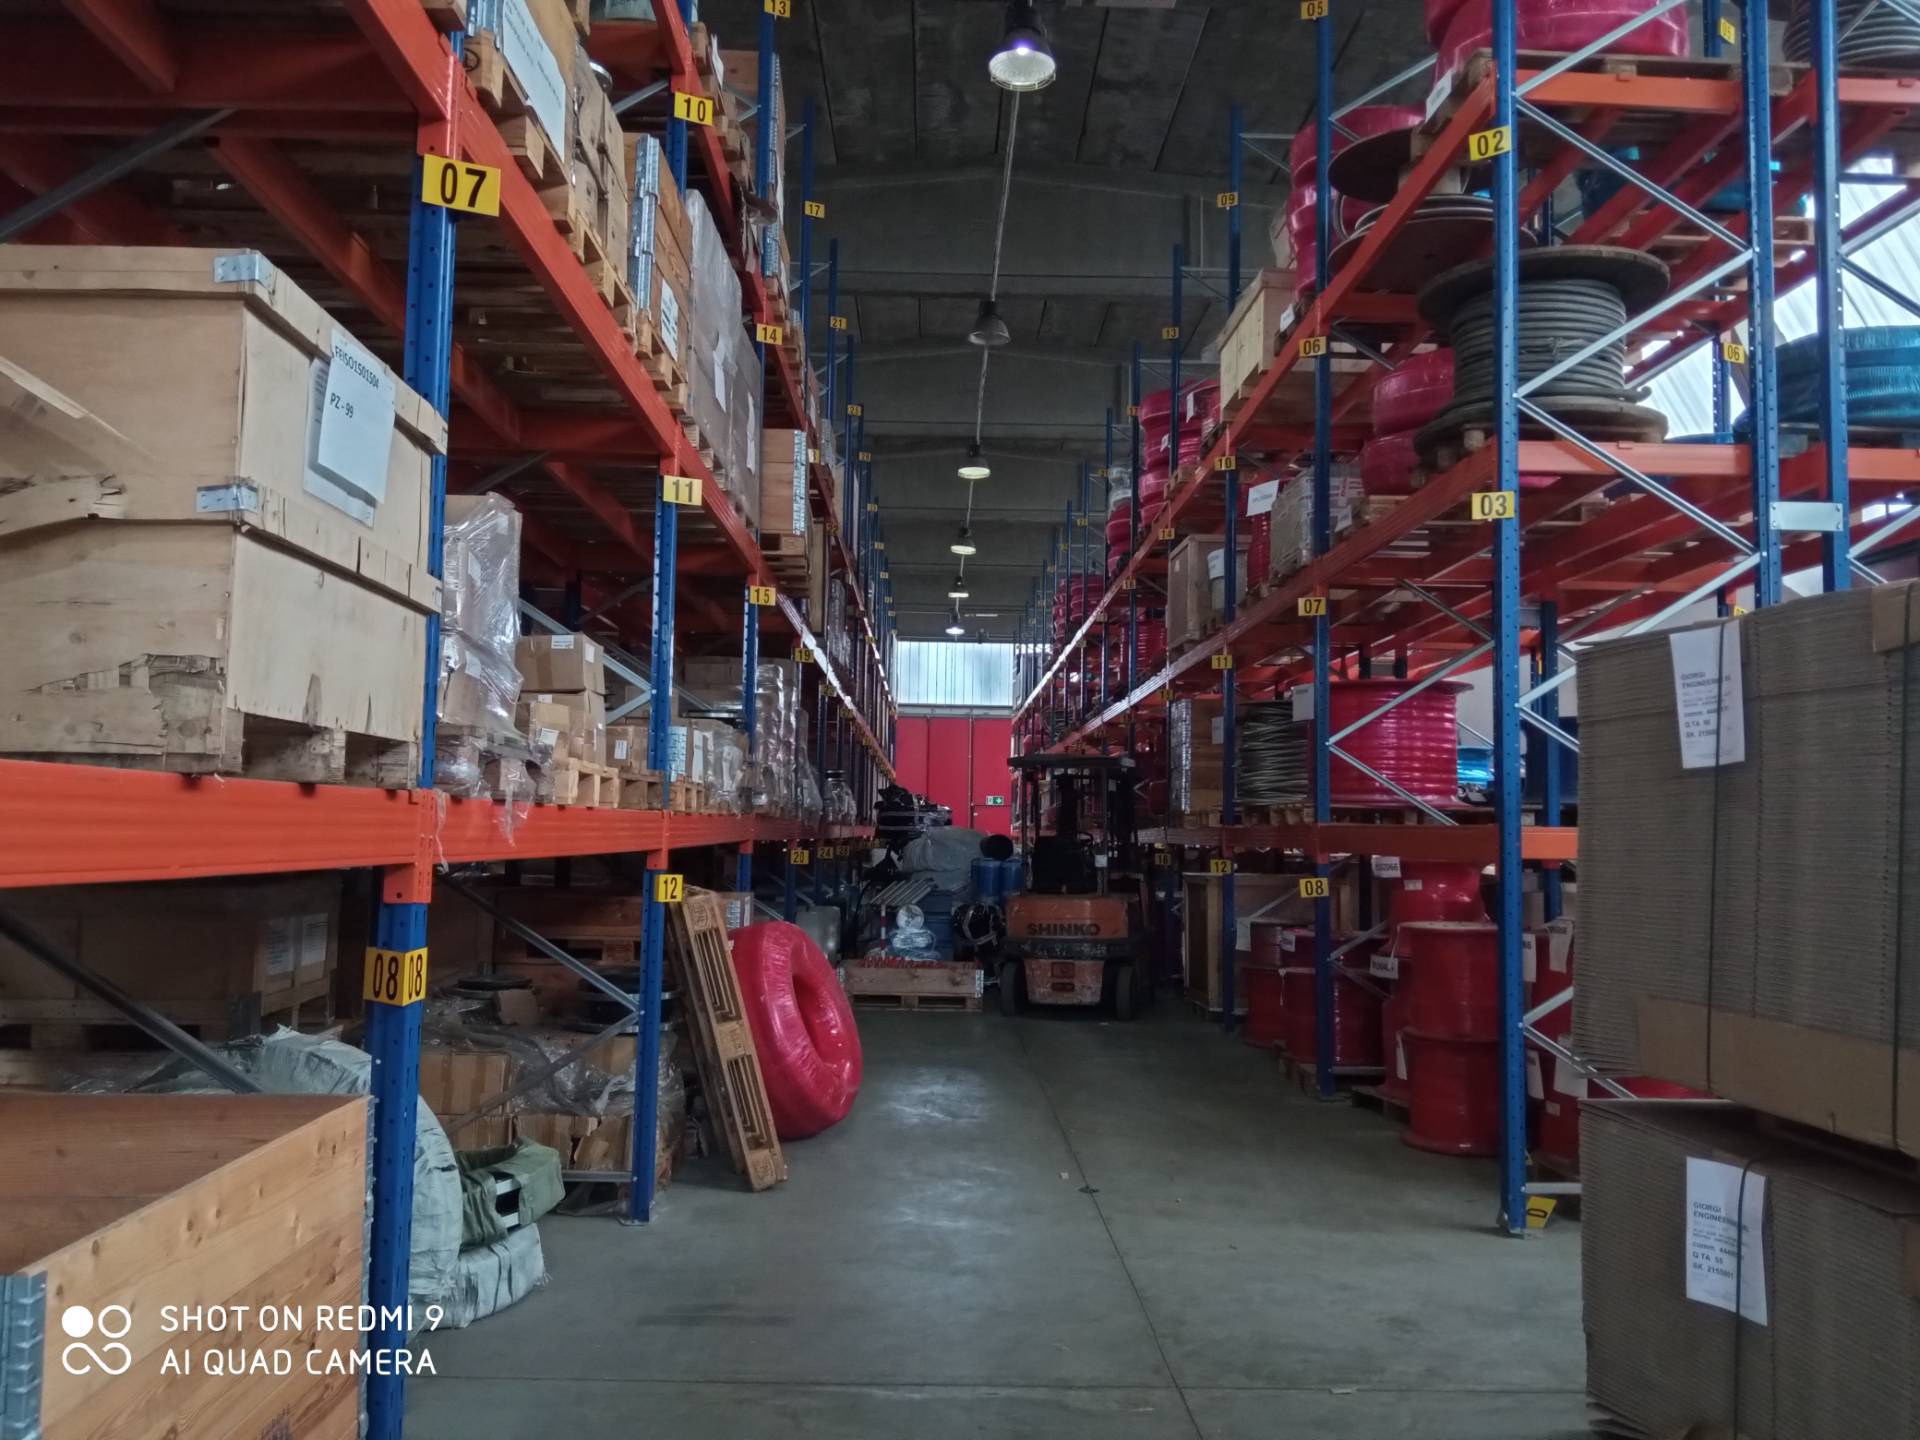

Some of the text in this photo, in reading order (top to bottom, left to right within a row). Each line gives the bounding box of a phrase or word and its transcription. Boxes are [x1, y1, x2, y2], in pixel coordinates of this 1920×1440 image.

[771, 0, 786, 15] 13
[684, 97, 706, 122] 10
[1477, 131, 1505, 156] 02
[440, 162, 487, 207] 07
[1221, 195, 1235, 206] 09
[809, 205, 820, 216] 17
[832, 318, 842, 328] 21
[762, 328, 777, 342] 14
[1304, 339, 1321, 354] 06
[1727, 345, 1740, 361] 06
[1217, 457, 1232, 469] 10
[672, 479, 693, 503] 11
[1480, 494, 1508, 517] 03
[755, 588, 769, 604] 15
[1304, 599, 1321, 614] 07
[1215, 656, 1228, 667] 11
[1214, 862, 1227, 873] 12
[663, 877, 678, 901] 12
[1305, 880, 1323, 895] 08
[1027, 923, 1101, 936] SHINKO
[373, 953, 399, 1000] 08
[408, 953, 423, 998] 08
